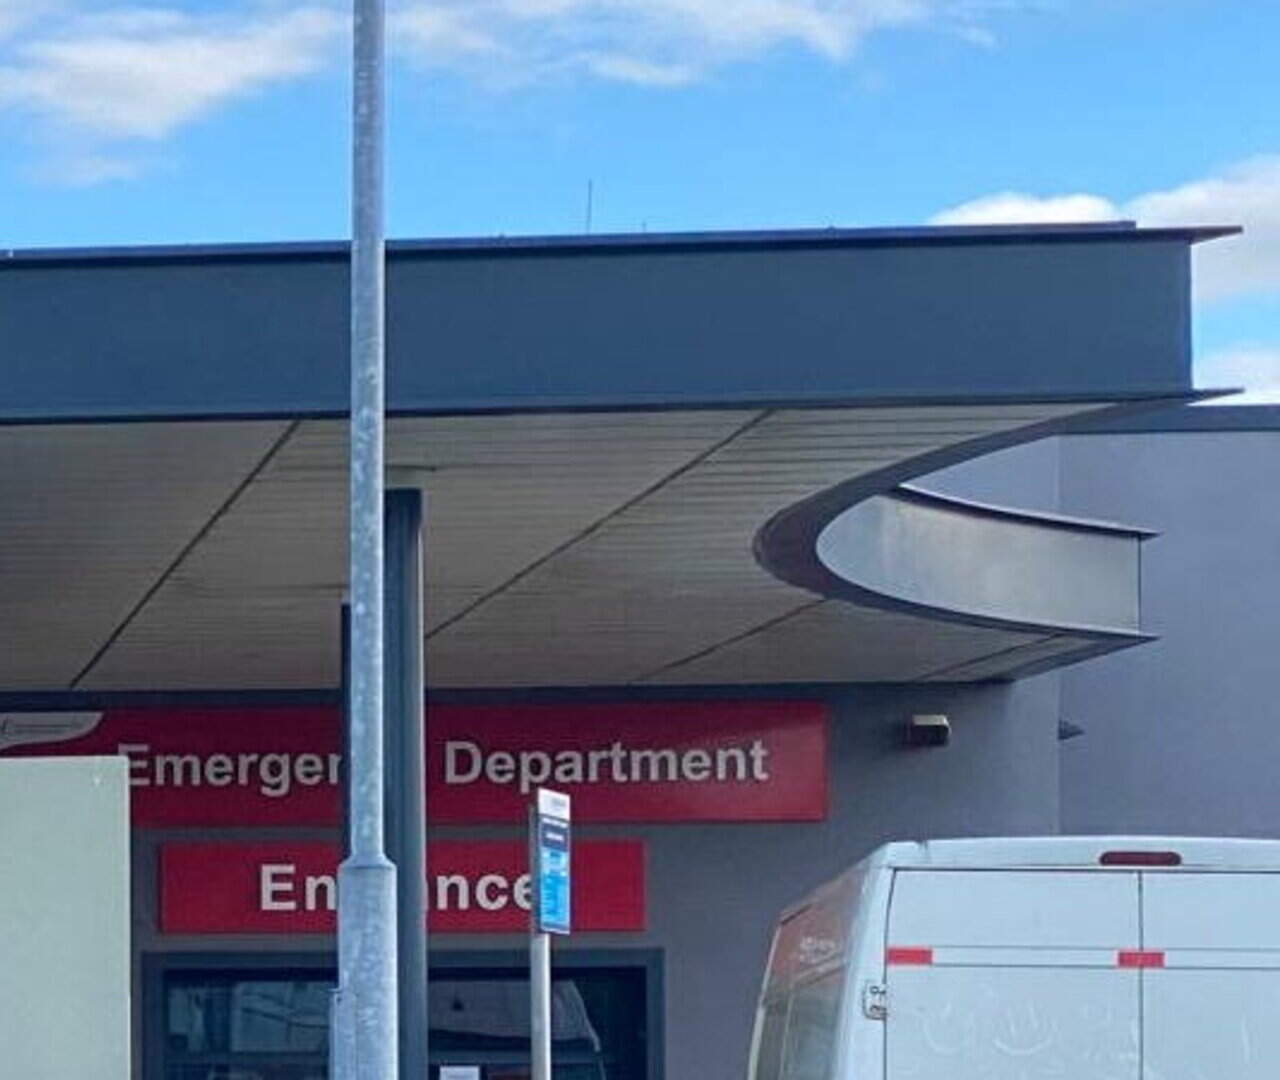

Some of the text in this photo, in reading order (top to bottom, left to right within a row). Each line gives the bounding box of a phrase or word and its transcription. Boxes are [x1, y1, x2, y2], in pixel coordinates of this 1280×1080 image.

[118, 740, 769, 797] Emerge Department
[261, 863, 533, 911] Ennce
